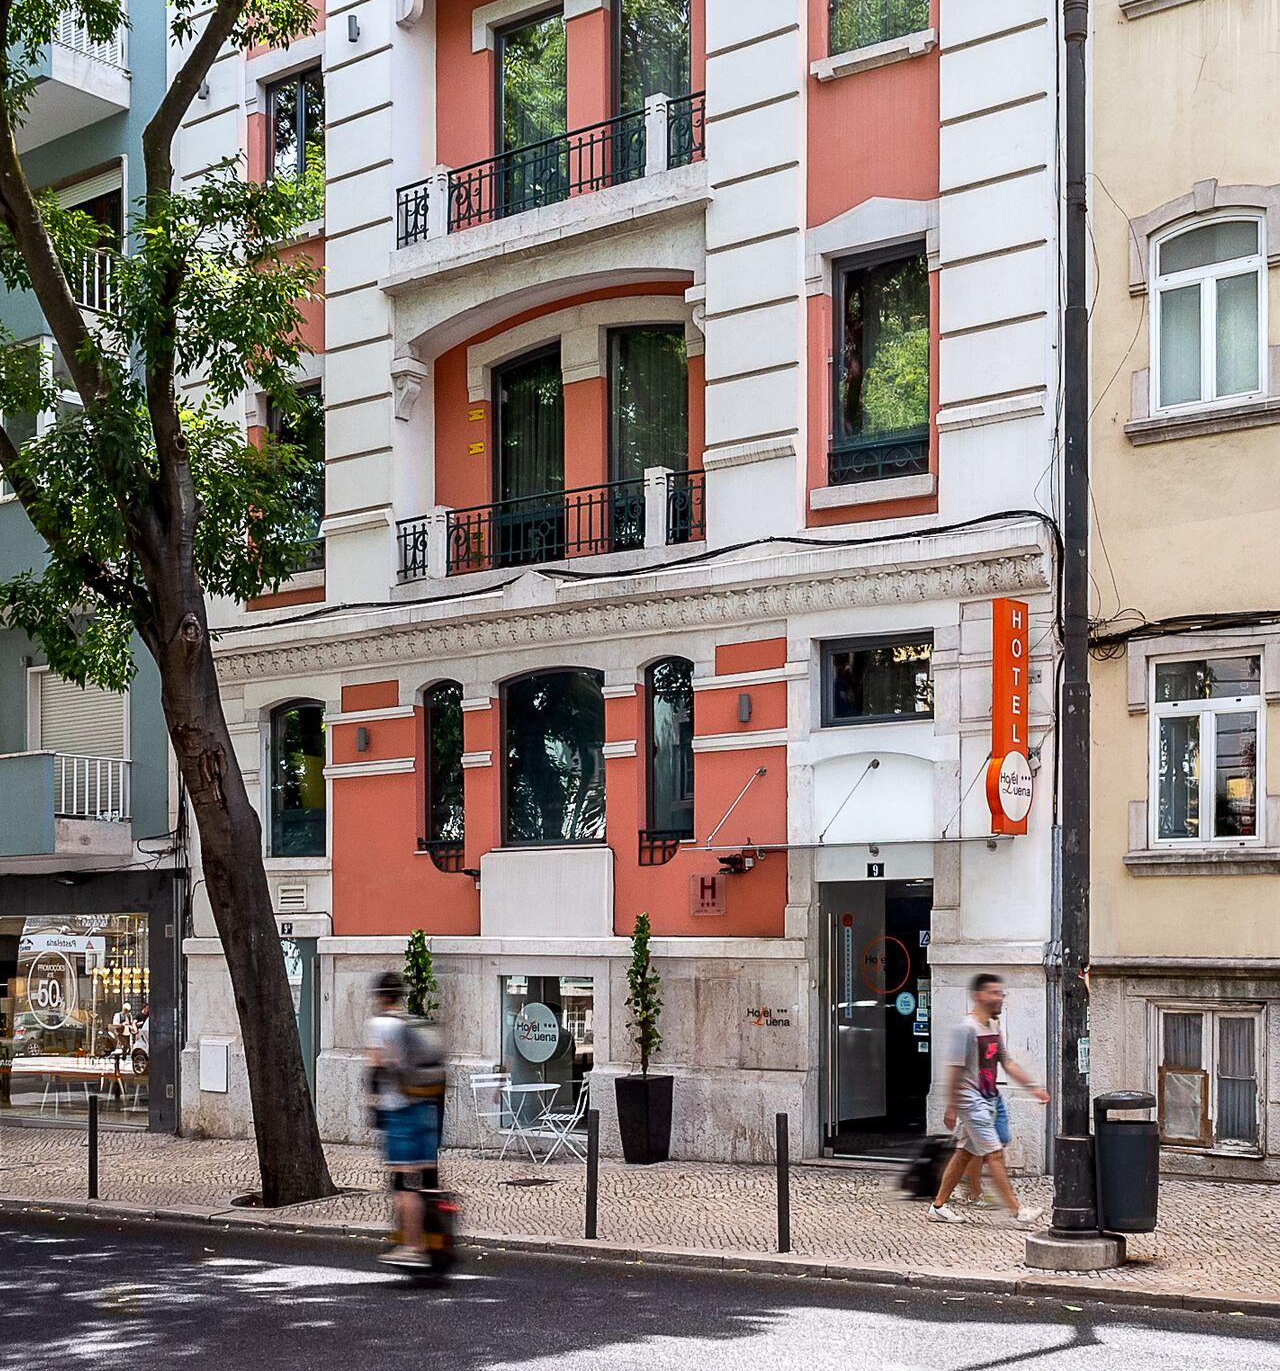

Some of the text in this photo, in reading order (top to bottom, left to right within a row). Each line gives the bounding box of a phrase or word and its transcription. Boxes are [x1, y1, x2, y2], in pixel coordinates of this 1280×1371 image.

[1011, 609, 1022, 743] HOTEL
[872, 864, 879, 876] 9
[700, 876, 716, 899] H
[516, 1021, 540, 1033] Hotel
